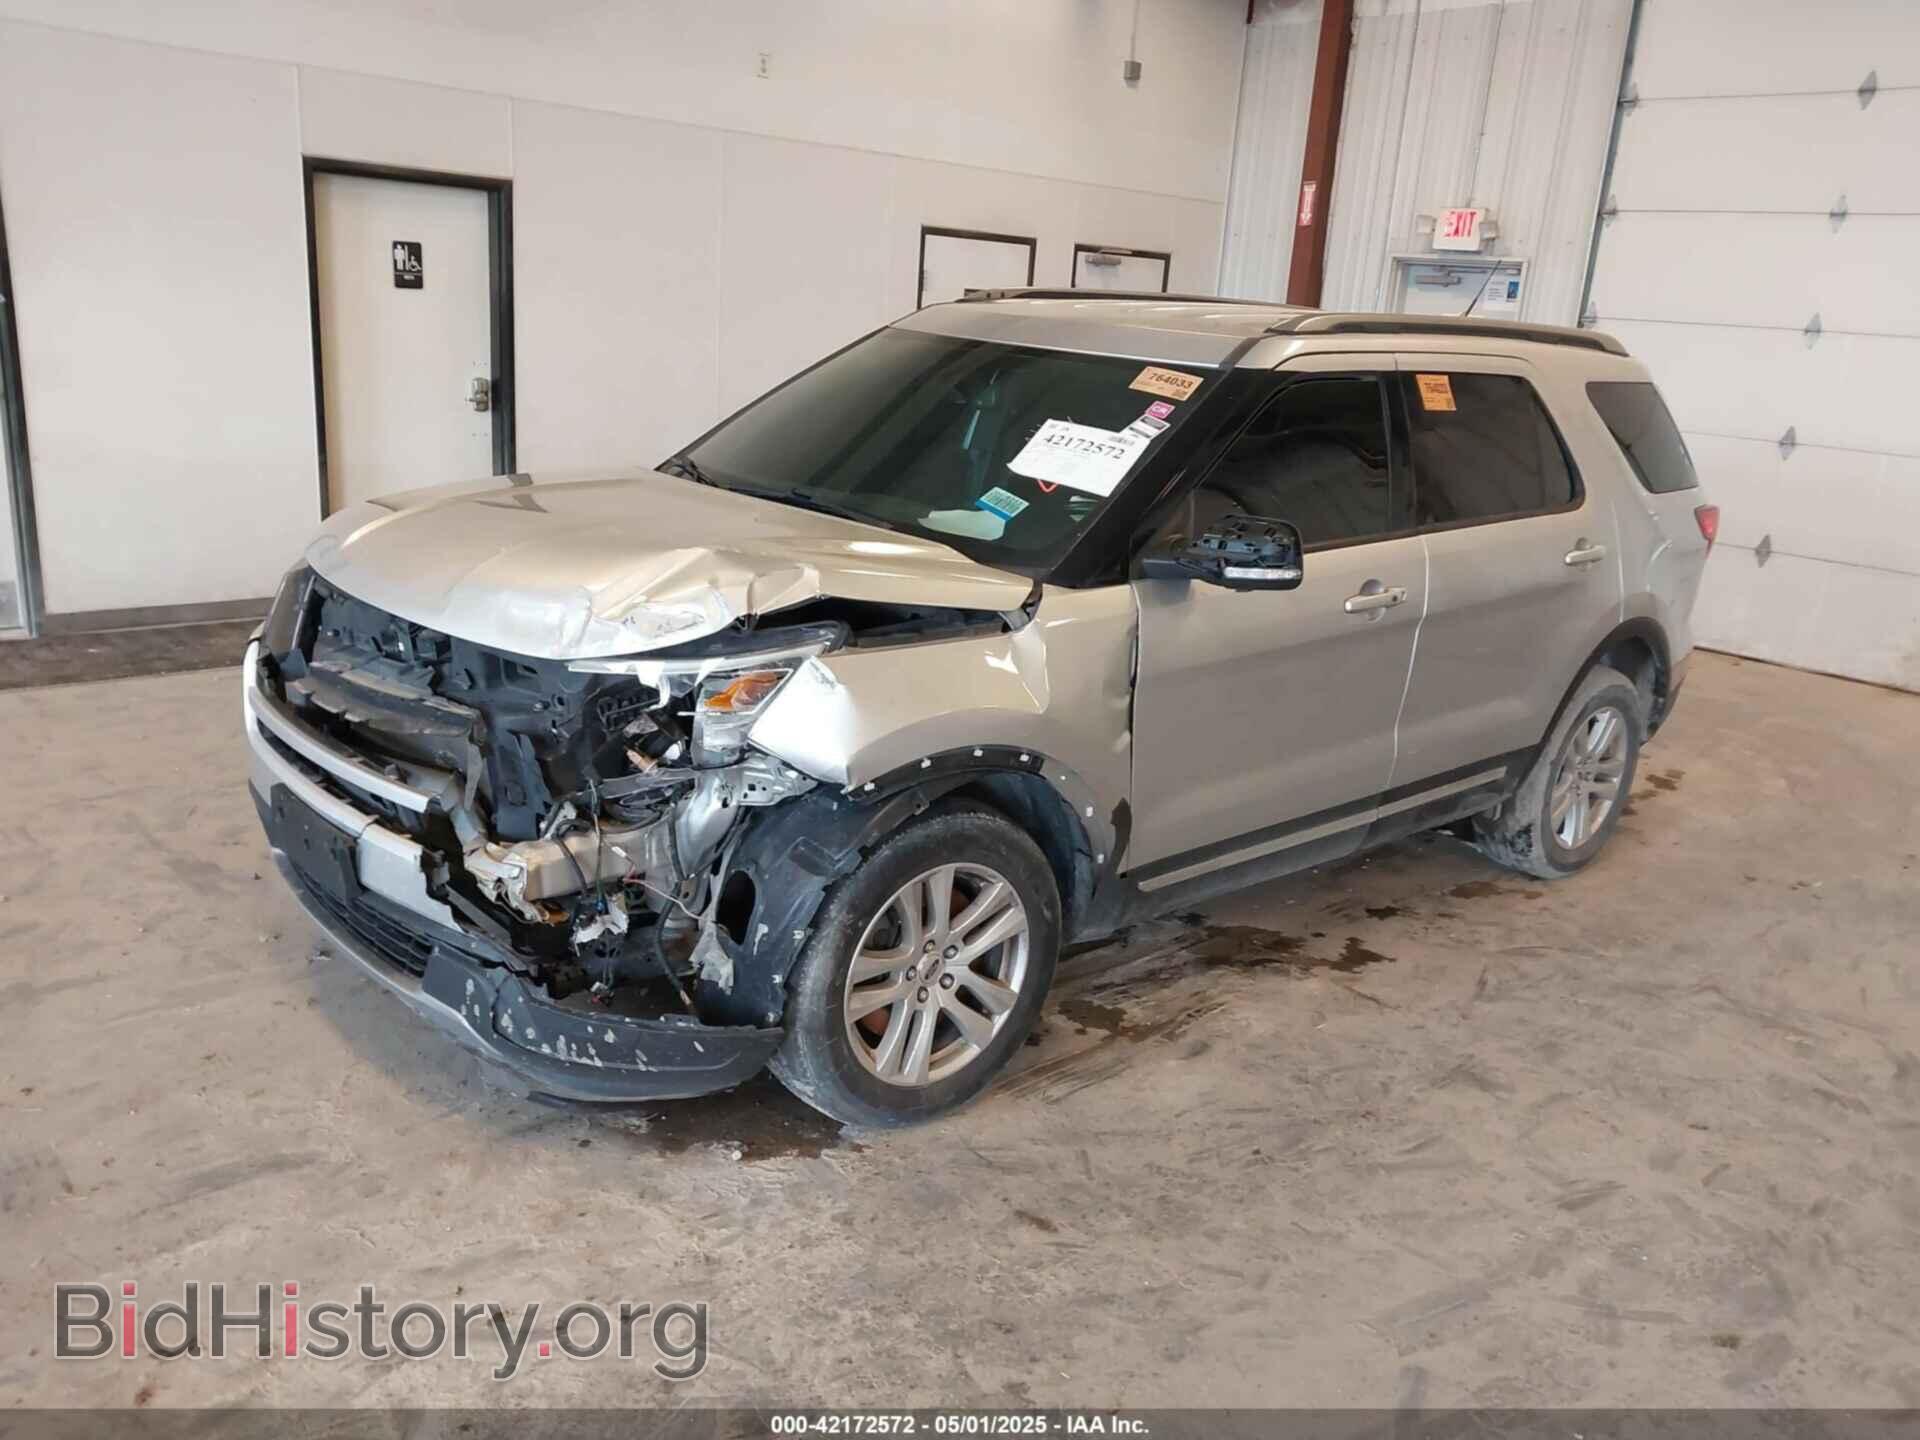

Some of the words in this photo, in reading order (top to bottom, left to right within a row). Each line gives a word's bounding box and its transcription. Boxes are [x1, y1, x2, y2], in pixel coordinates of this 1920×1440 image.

[1444, 210, 1477, 238] EXIT
[1149, 373, 1194, 389] 764033
[1043, 433, 1125, 460] 42172572
